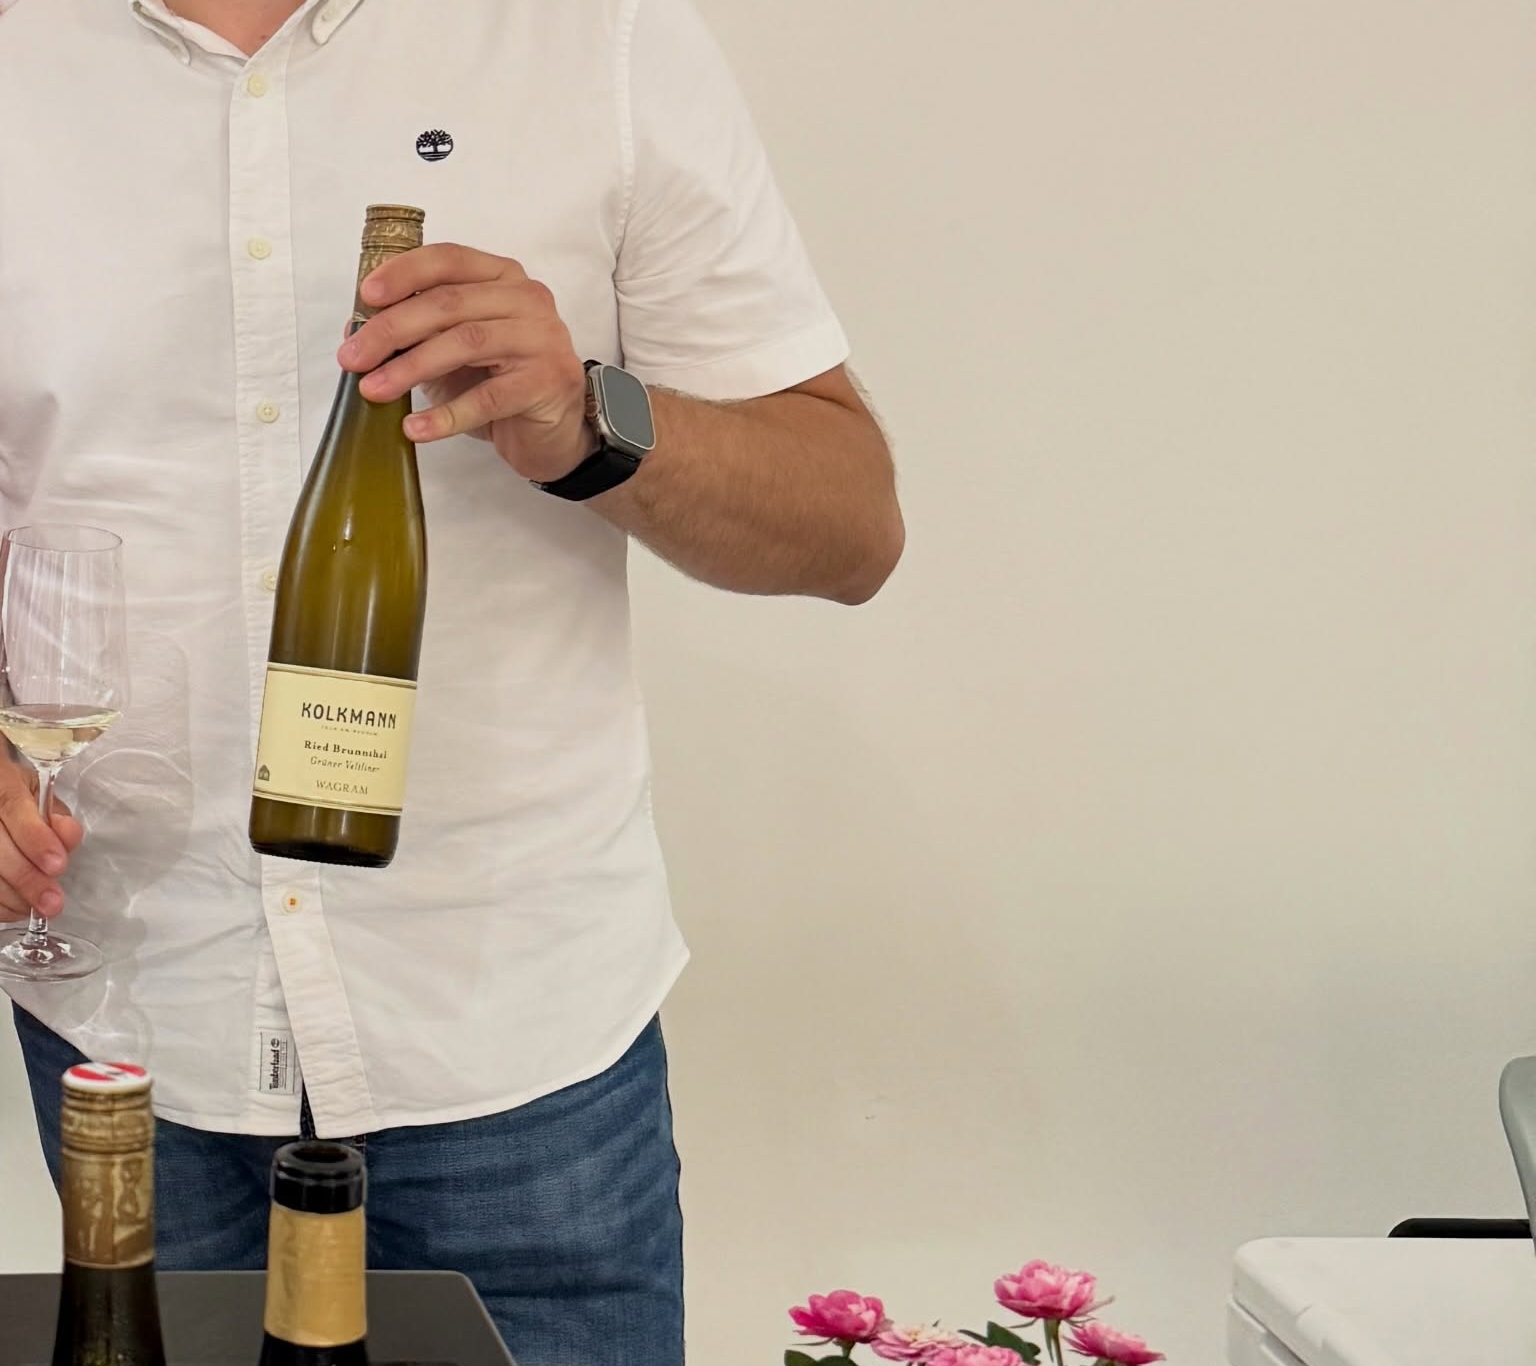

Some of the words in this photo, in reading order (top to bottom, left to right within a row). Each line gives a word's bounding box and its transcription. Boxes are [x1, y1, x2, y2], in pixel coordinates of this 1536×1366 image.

[302, 702, 397, 730] KOLKMANN
[304, 740, 329, 752] Ried
[316, 780, 368, 795] WAGRAM
